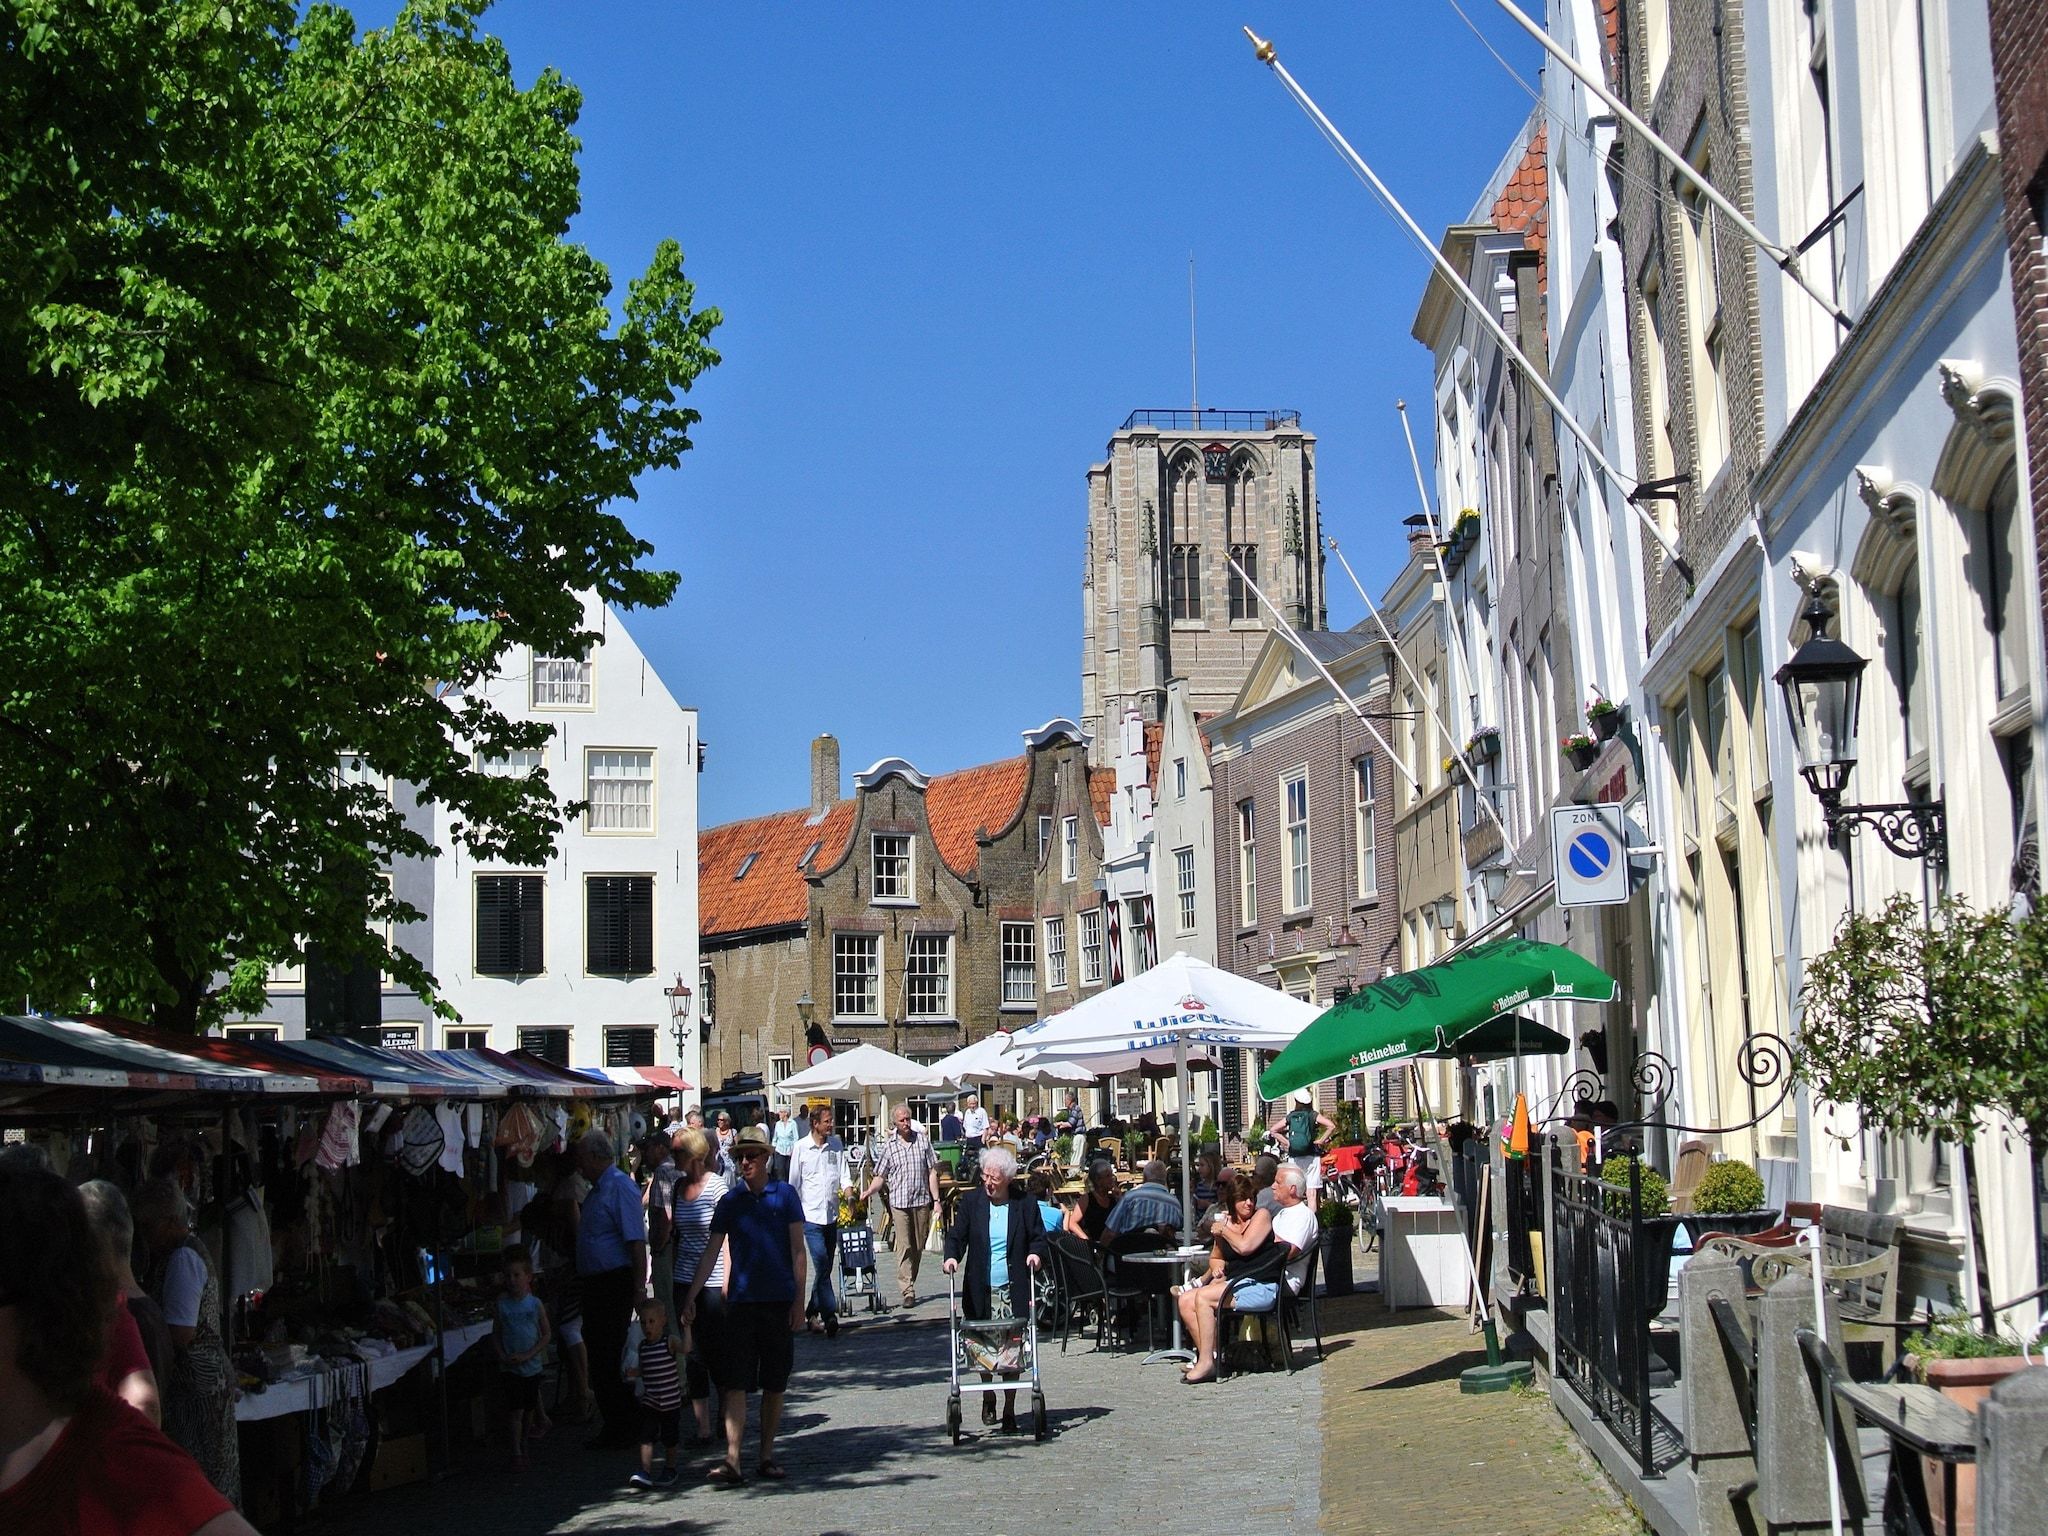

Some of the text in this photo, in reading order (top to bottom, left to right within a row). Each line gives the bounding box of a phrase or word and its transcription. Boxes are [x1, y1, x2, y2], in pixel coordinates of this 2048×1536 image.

[1572, 812, 1602, 824] ZONE
[1498, 986, 1530, 1011] Heineken
[1359, 1041, 1407, 1064] Heineken
